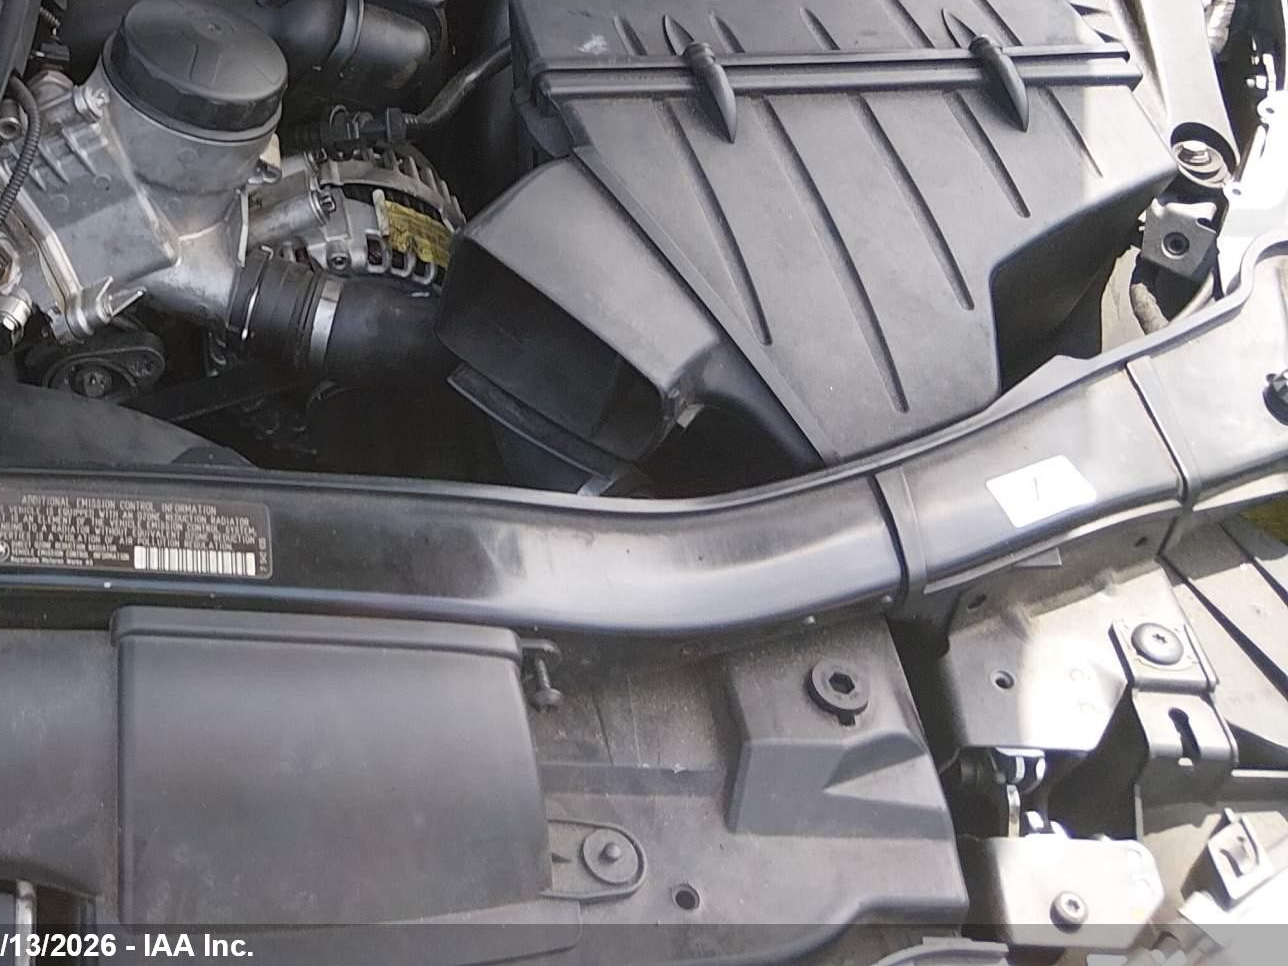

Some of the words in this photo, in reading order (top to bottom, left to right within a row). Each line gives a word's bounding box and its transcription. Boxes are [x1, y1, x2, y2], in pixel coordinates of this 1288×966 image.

[21, 495, 69, 507] ADDITIONAL
[76, 497, 116, 509] EMISSION
[119, 500, 155, 512] CONTROL
[161, 502, 217, 515] INFORMATION
